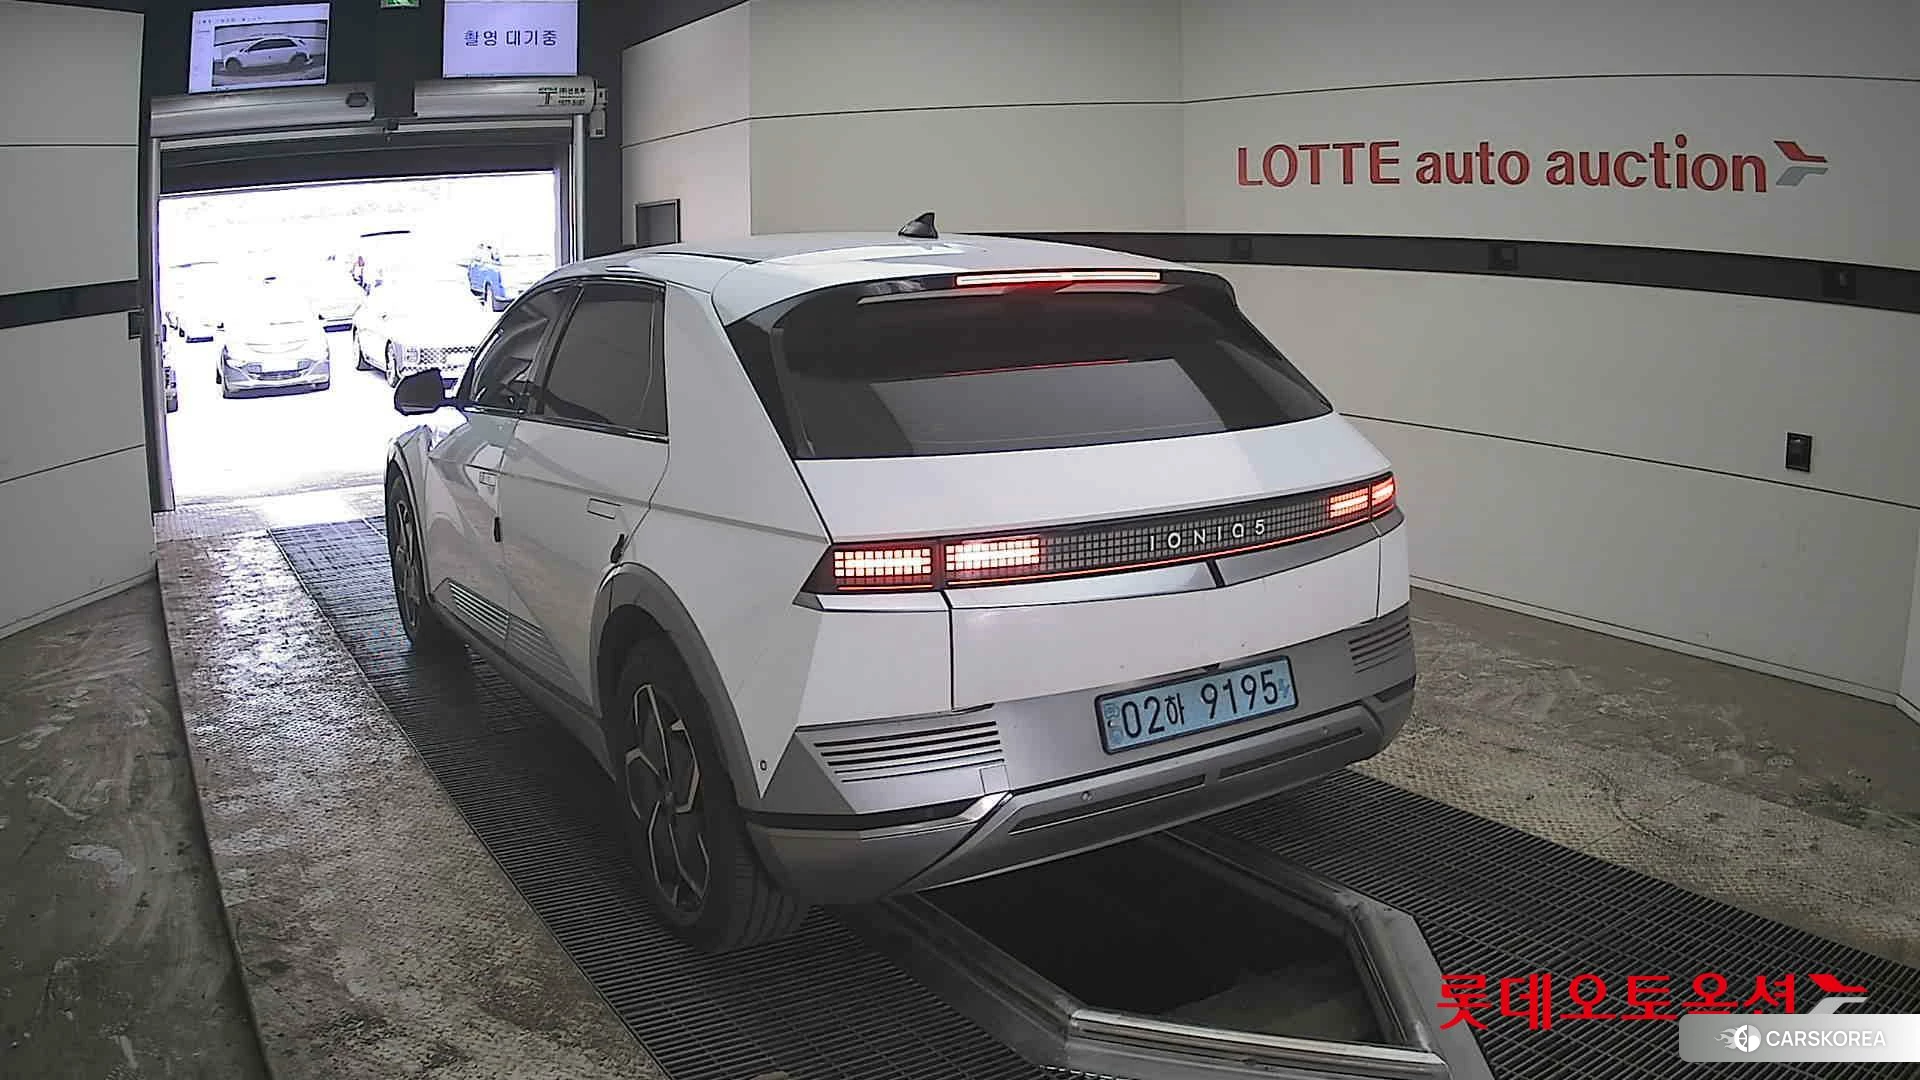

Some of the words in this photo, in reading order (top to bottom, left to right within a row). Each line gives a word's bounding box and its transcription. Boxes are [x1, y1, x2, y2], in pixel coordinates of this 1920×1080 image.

[463, 29, 497, 46] 촬영
[506, 29, 557, 46] 대기중
[1238, 141, 1400, 187] LOTTE
[1415, 141, 1531, 185] auto
[1545, 134, 1767, 193] auction
[1150, 523, 1244, 551] IONIQ
[1255, 519, 1265, 535] 5
[1121, 692, 1185, 738] 02하
[1200, 669, 1278, 719] 9195
